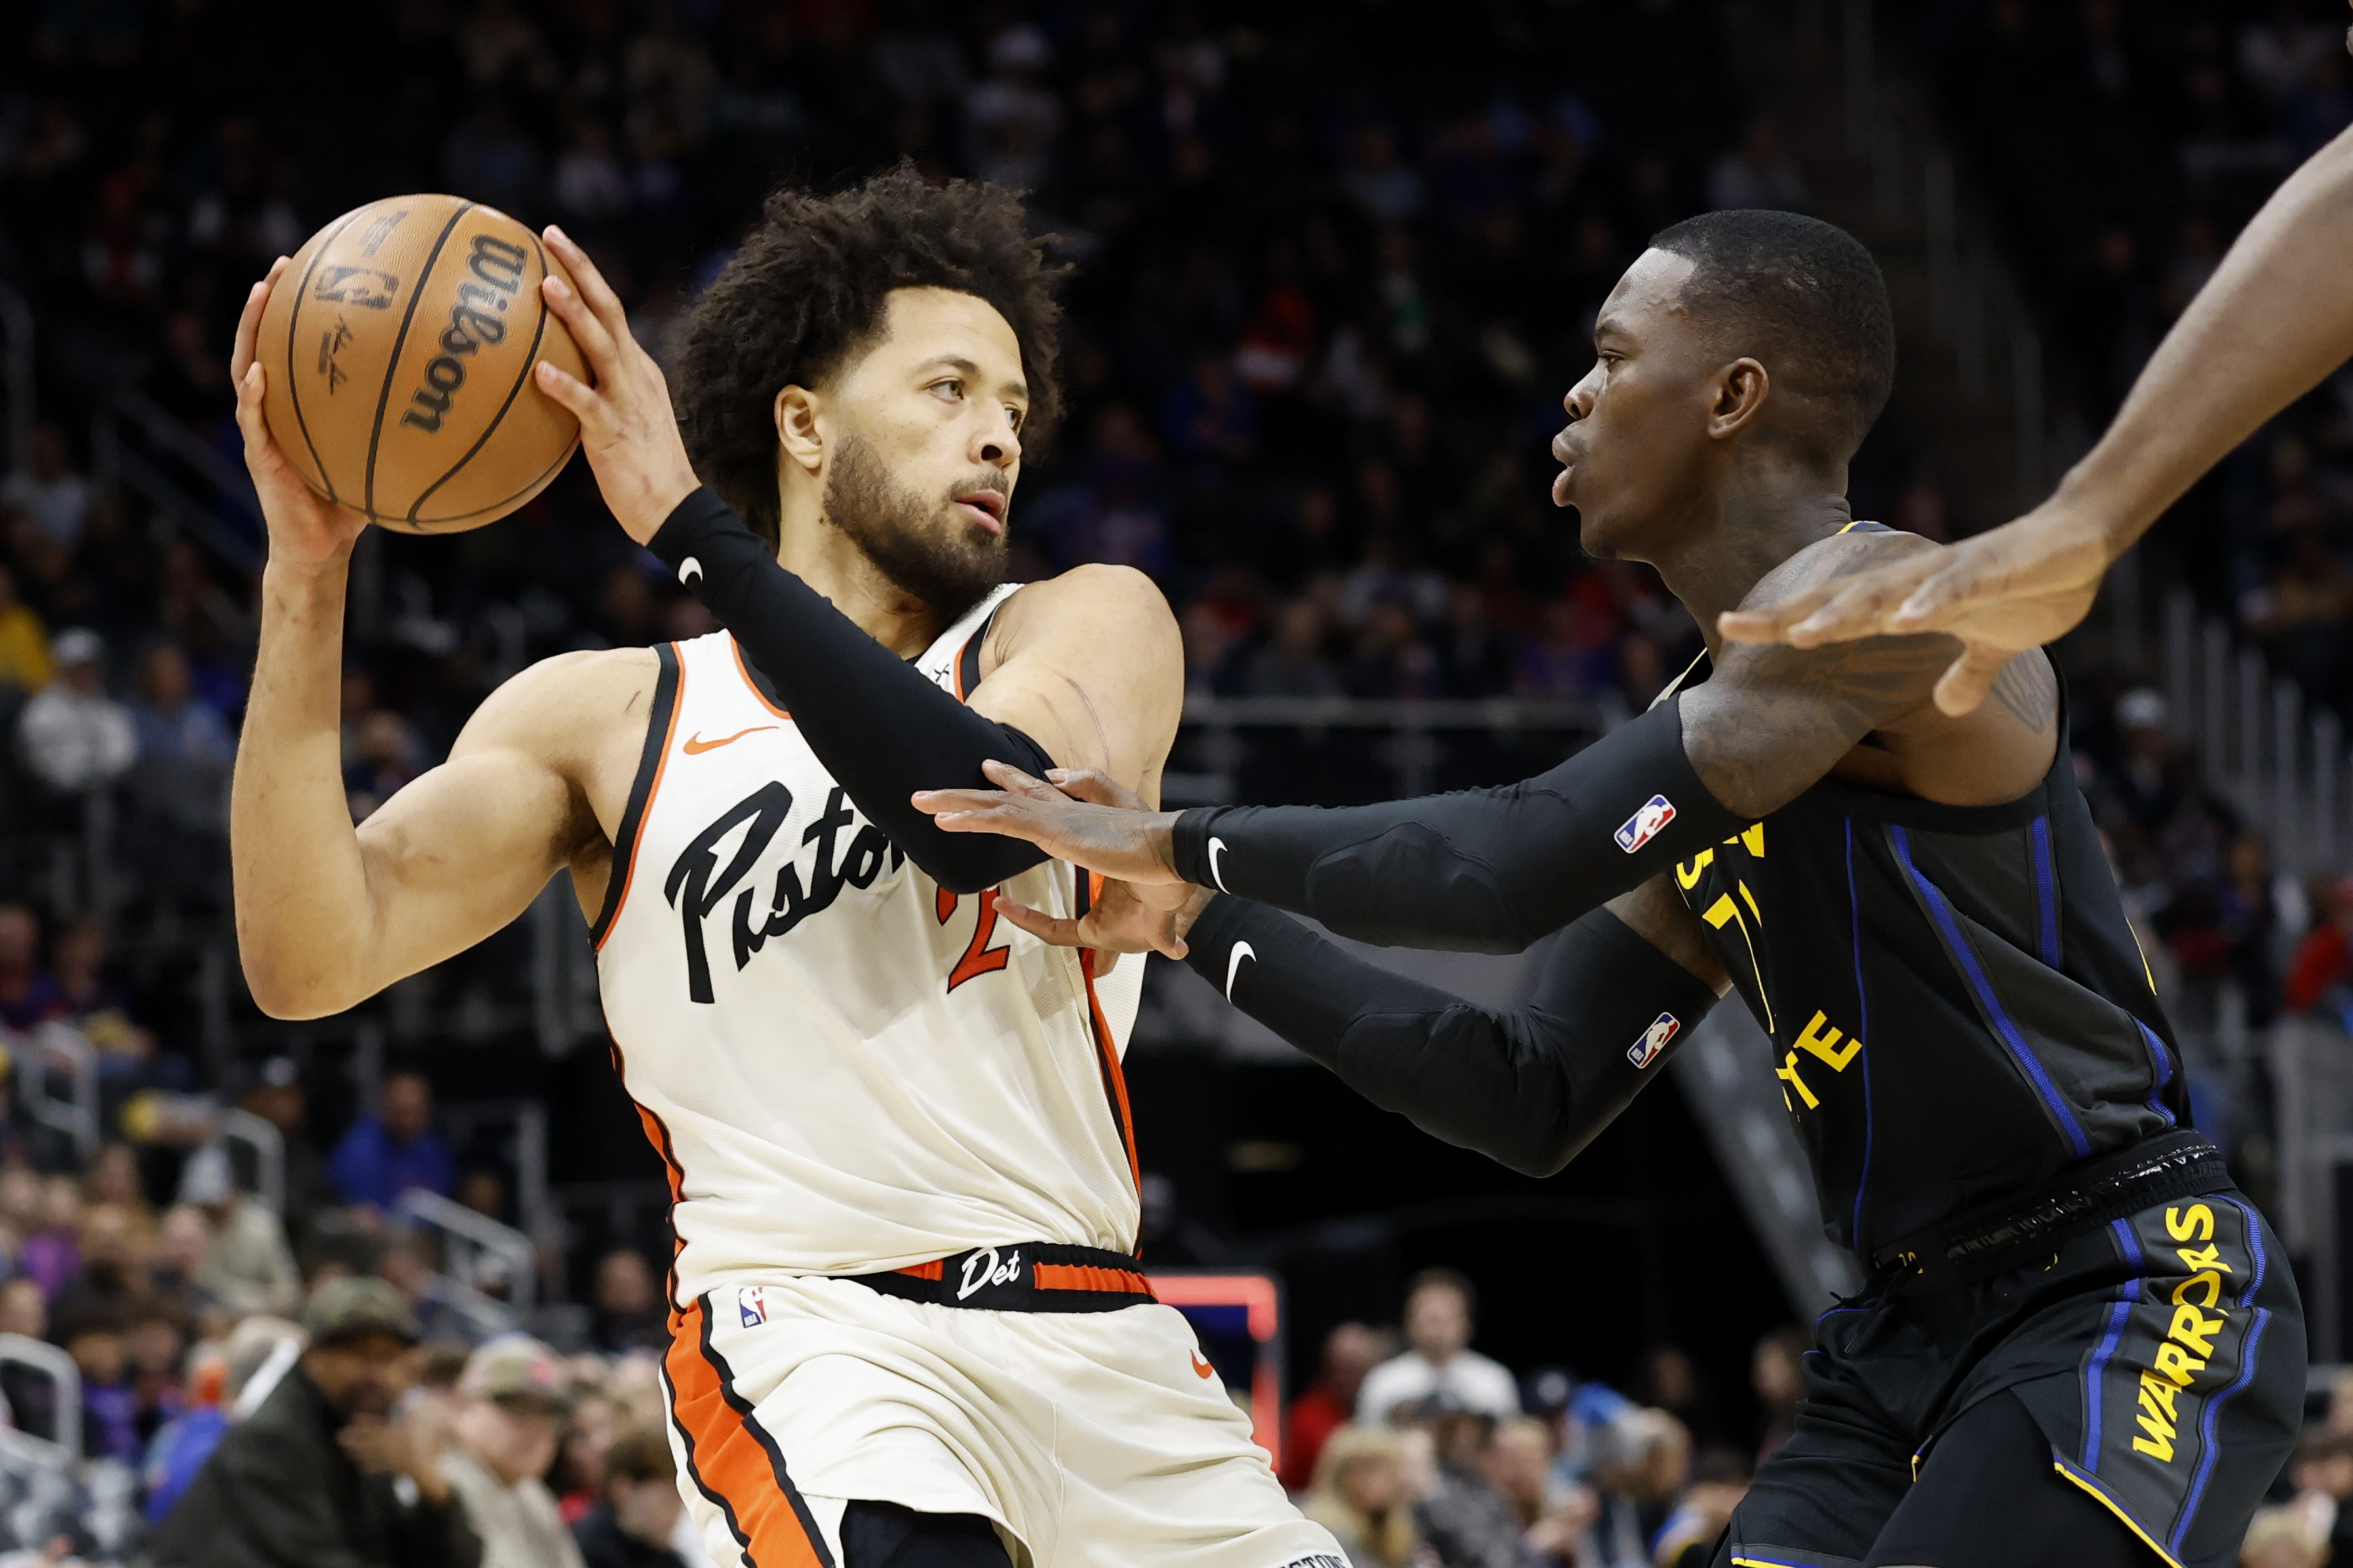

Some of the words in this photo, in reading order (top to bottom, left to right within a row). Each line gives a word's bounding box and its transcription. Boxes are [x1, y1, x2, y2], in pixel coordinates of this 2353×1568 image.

[400, 235, 527, 434] Wilson
[664, 780, 904, 1004] Pisto
[935, 886, 1011, 994] 2
[1630, 1047, 1644, 1062] NBA
[743, 1312, 758, 1328] NBA
[956, 1247, 1021, 1301] Det
[2132, 1204, 2232, 1463] WARRORS
